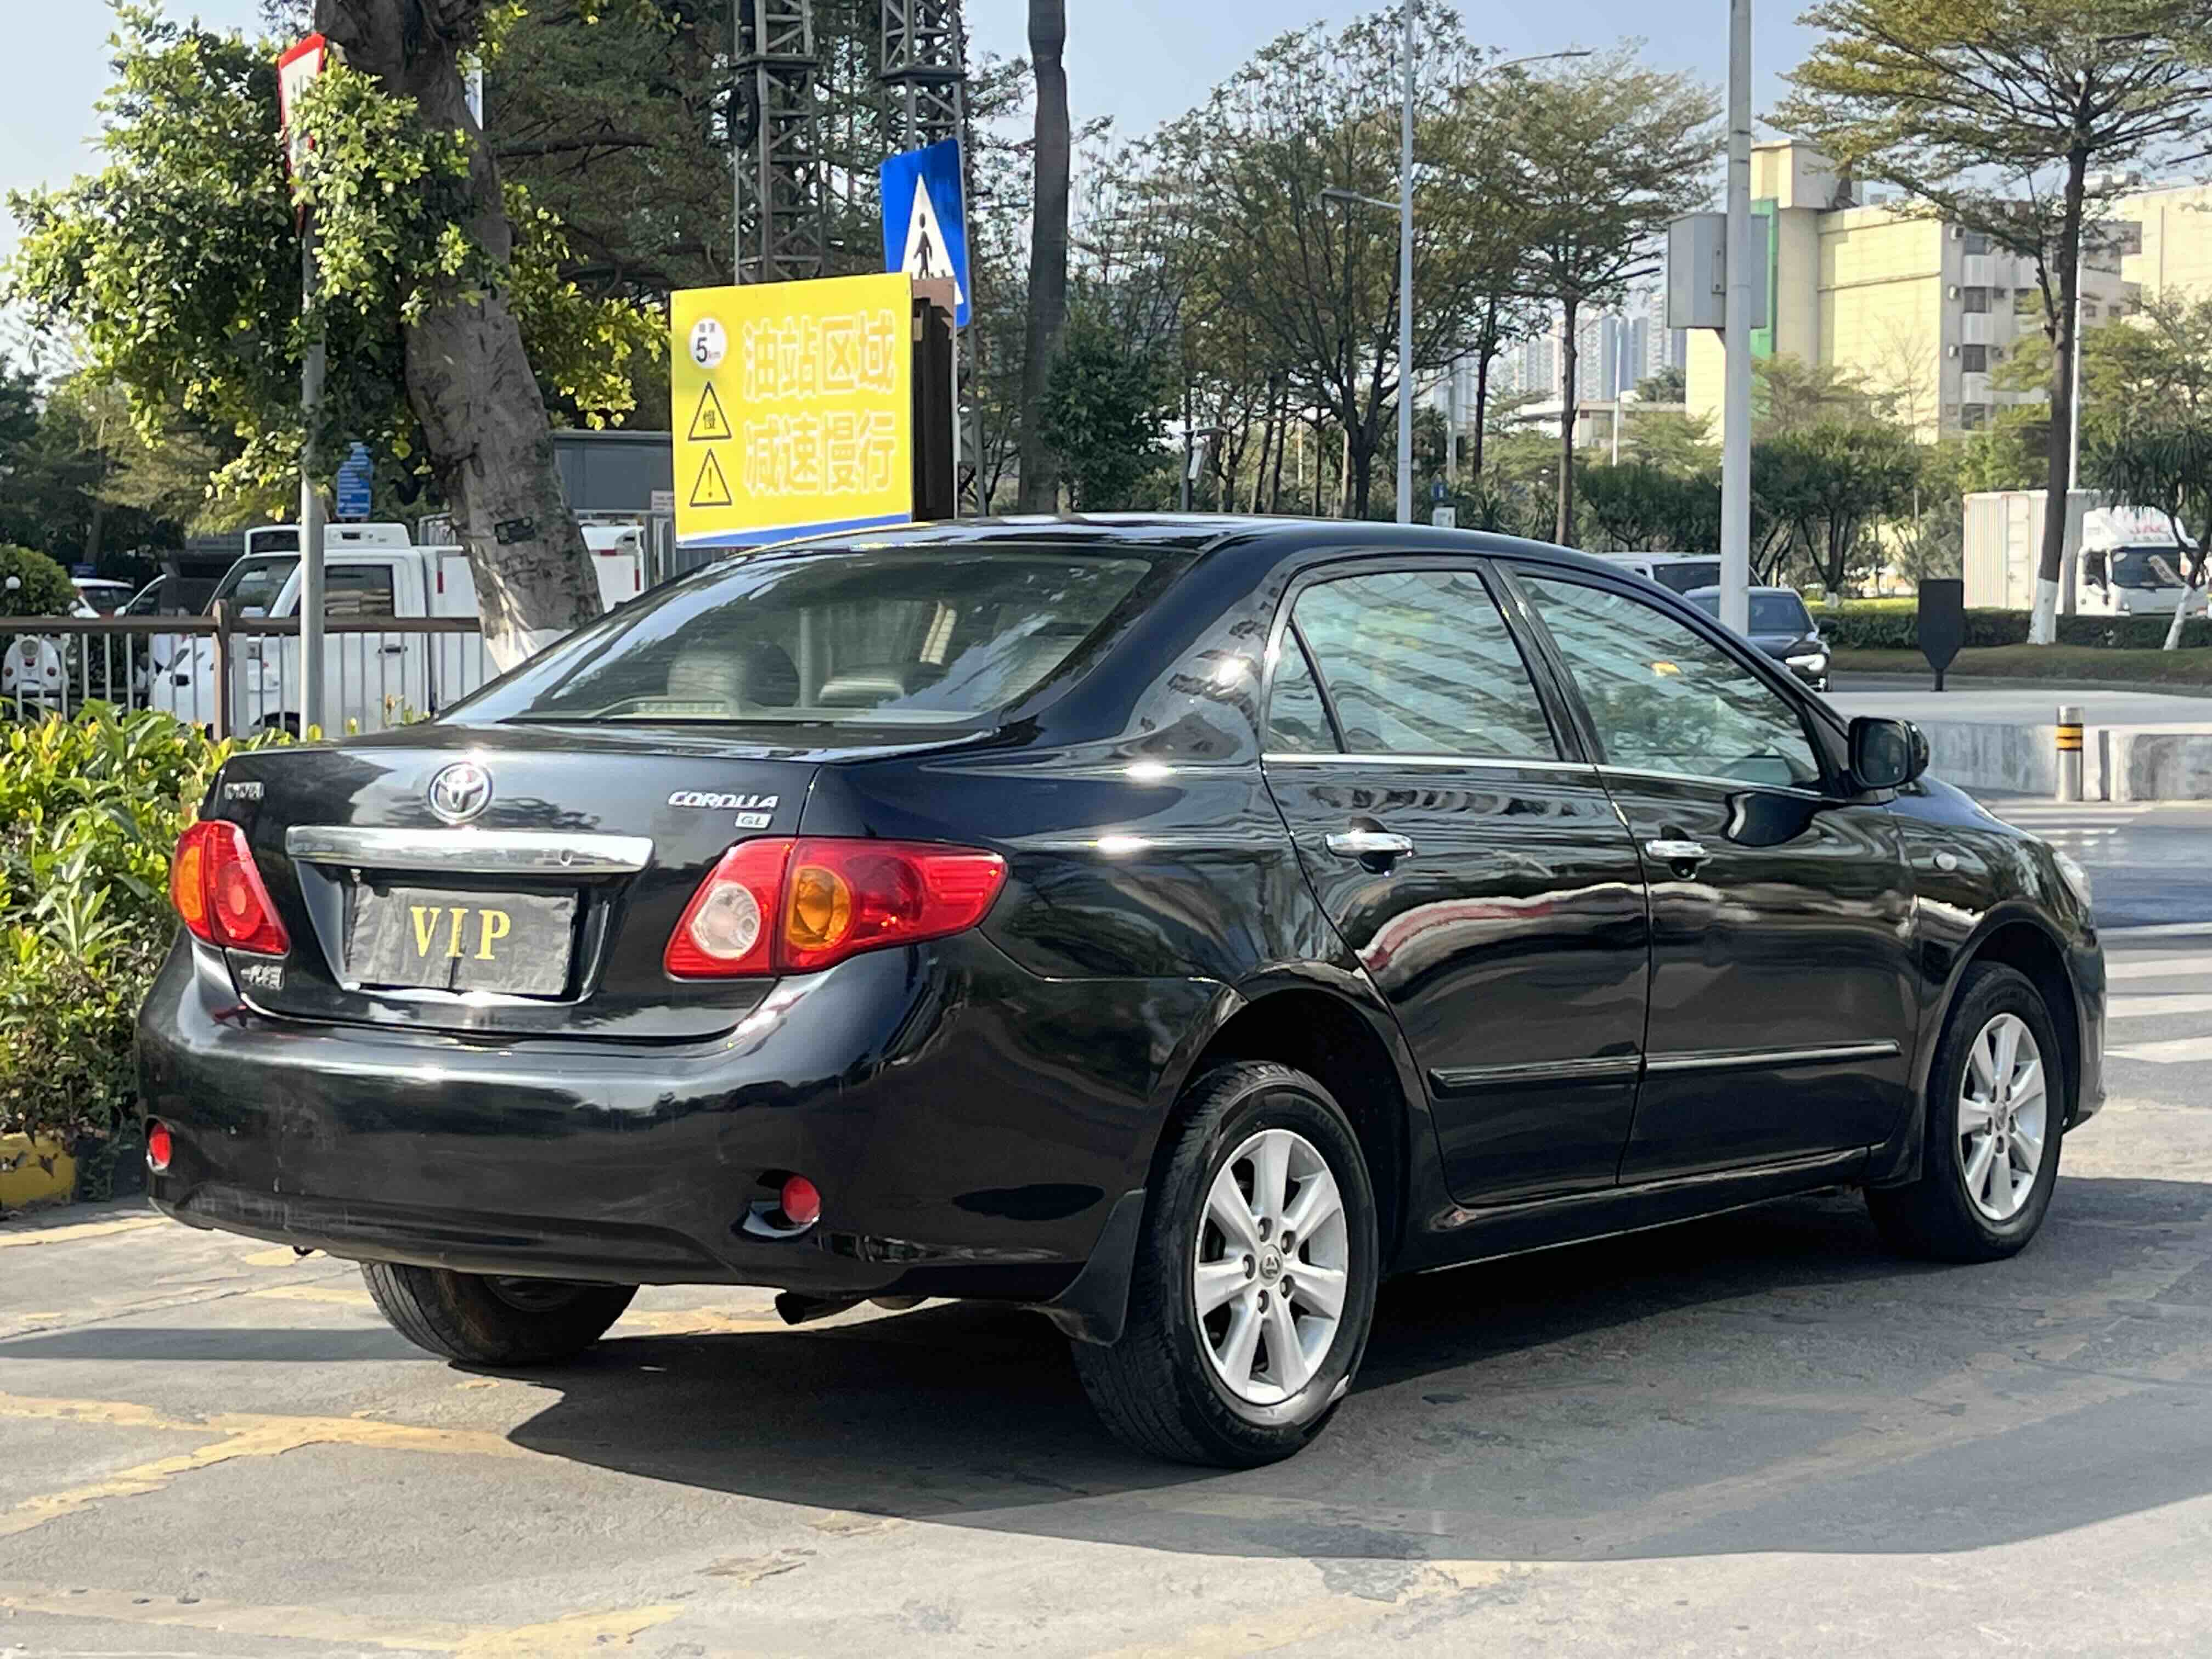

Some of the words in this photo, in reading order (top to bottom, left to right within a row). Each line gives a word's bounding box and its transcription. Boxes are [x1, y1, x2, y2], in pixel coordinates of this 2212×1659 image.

[743, 310, 896, 402] 油站区域
[743, 409, 896, 496] 减速慢行
[668, 791, 780, 808] COROLLA
[410, 906, 511, 960] VIP
